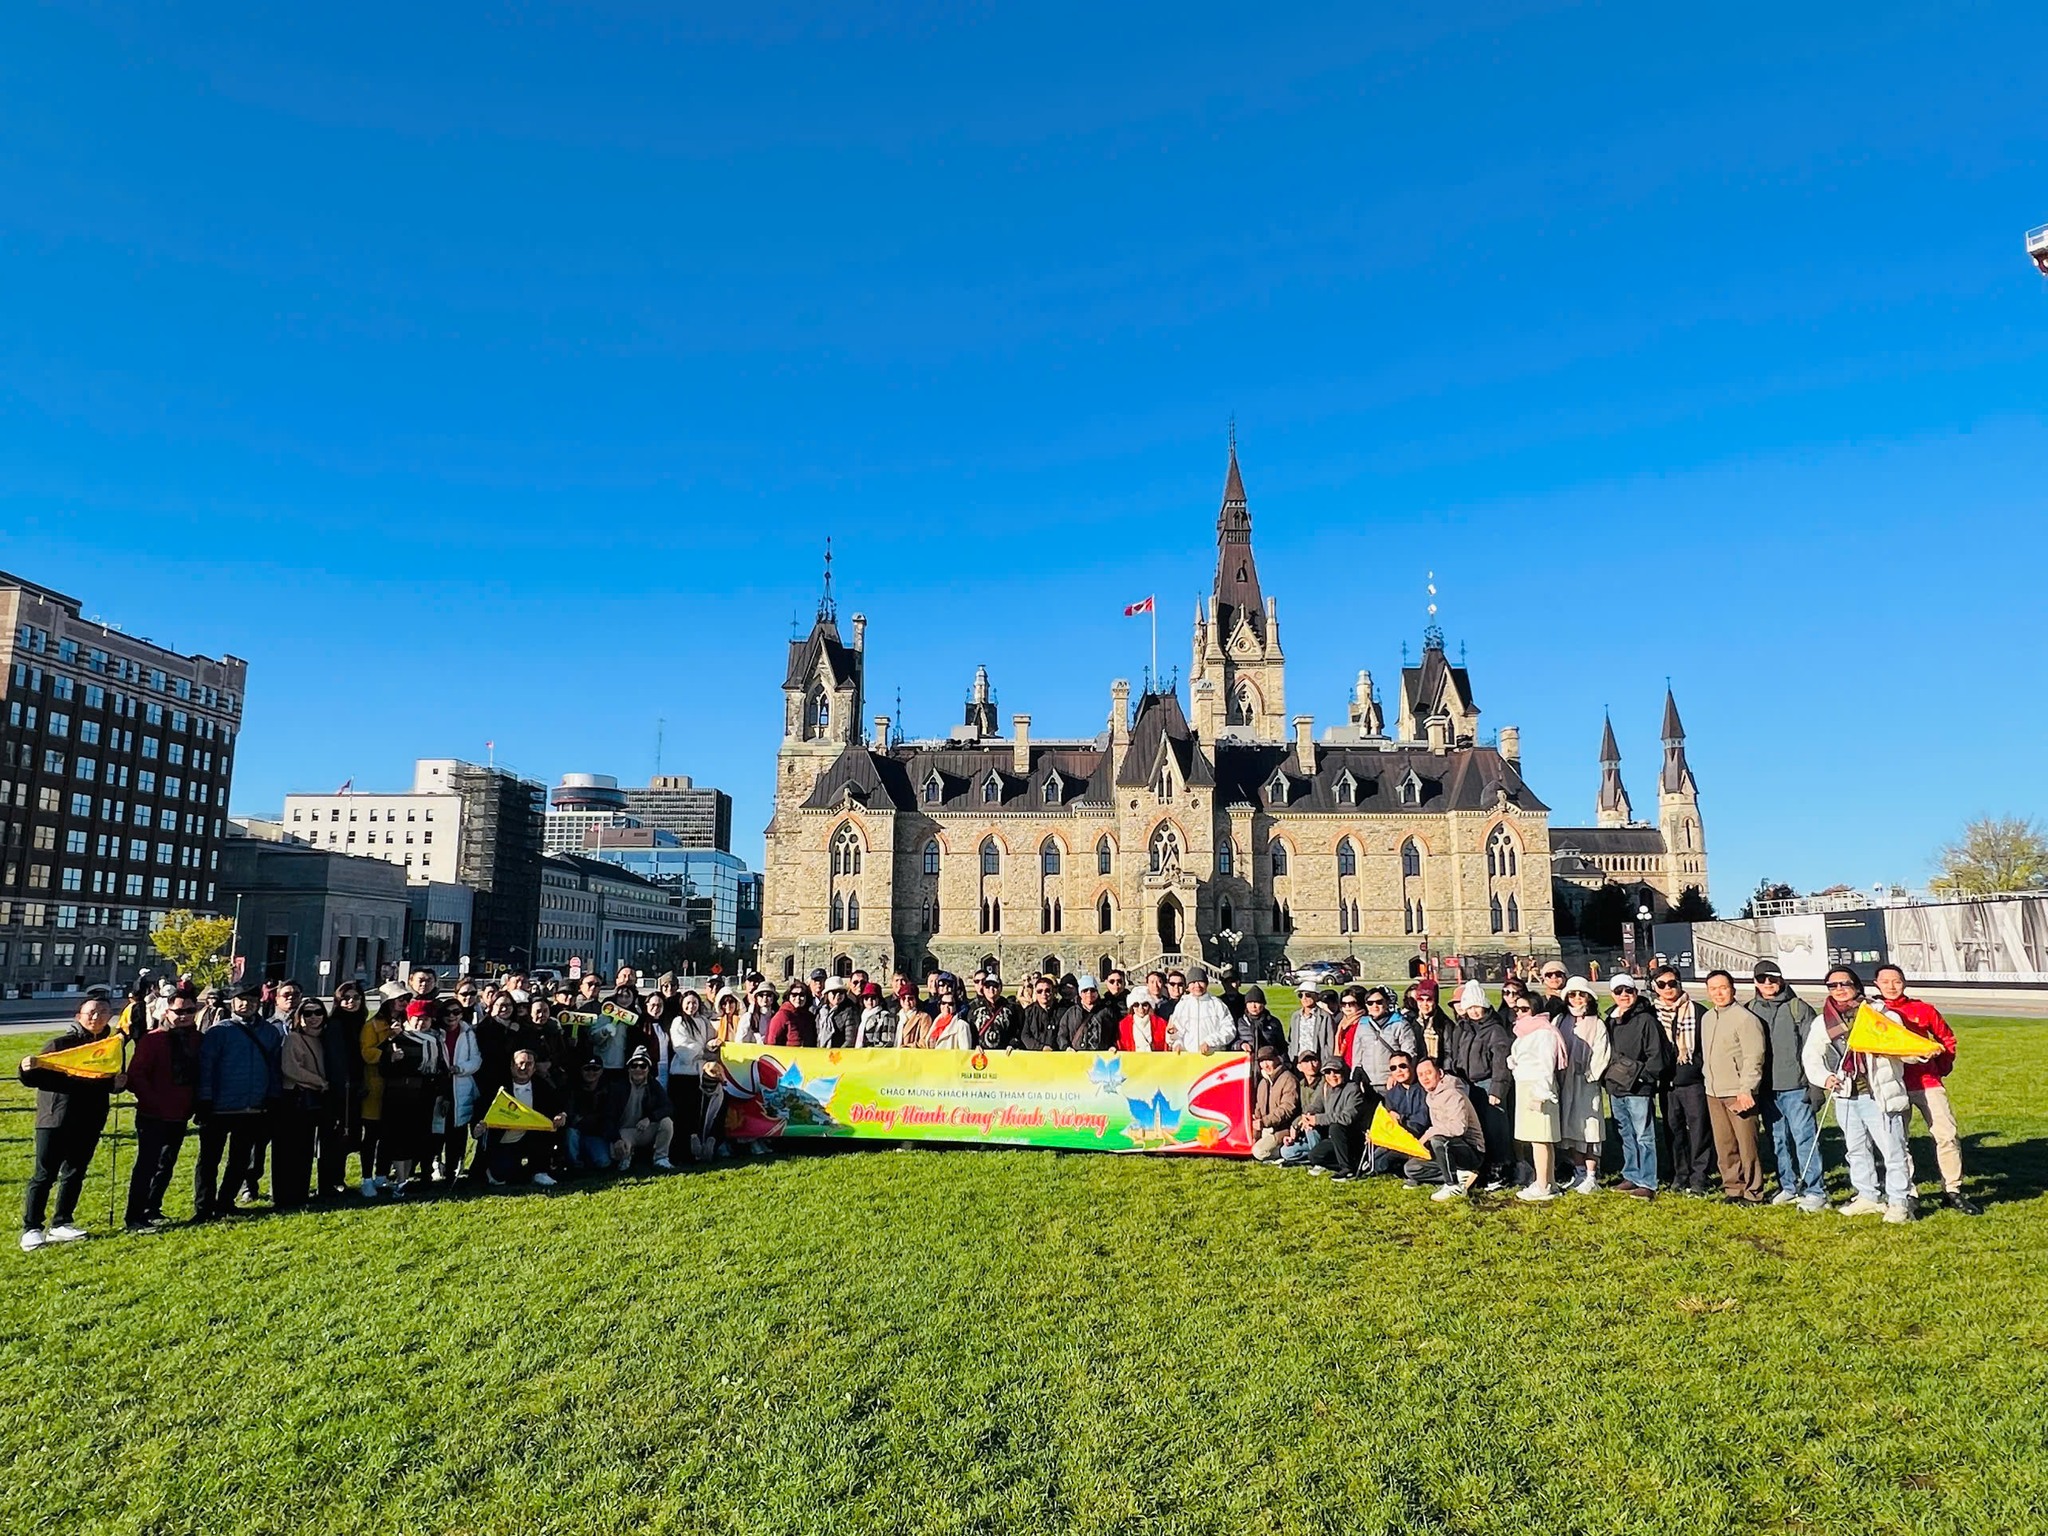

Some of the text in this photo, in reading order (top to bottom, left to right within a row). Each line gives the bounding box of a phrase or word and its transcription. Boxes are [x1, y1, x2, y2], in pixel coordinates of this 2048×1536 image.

[573, 1014, 585, 1023] XE
[616, 1009, 628, 1019] XE
[1000, 1091, 1025, 1099] THAM
[1027, 1091, 1041, 1100] GIA
[1045, 1091, 1057, 1100] DU
